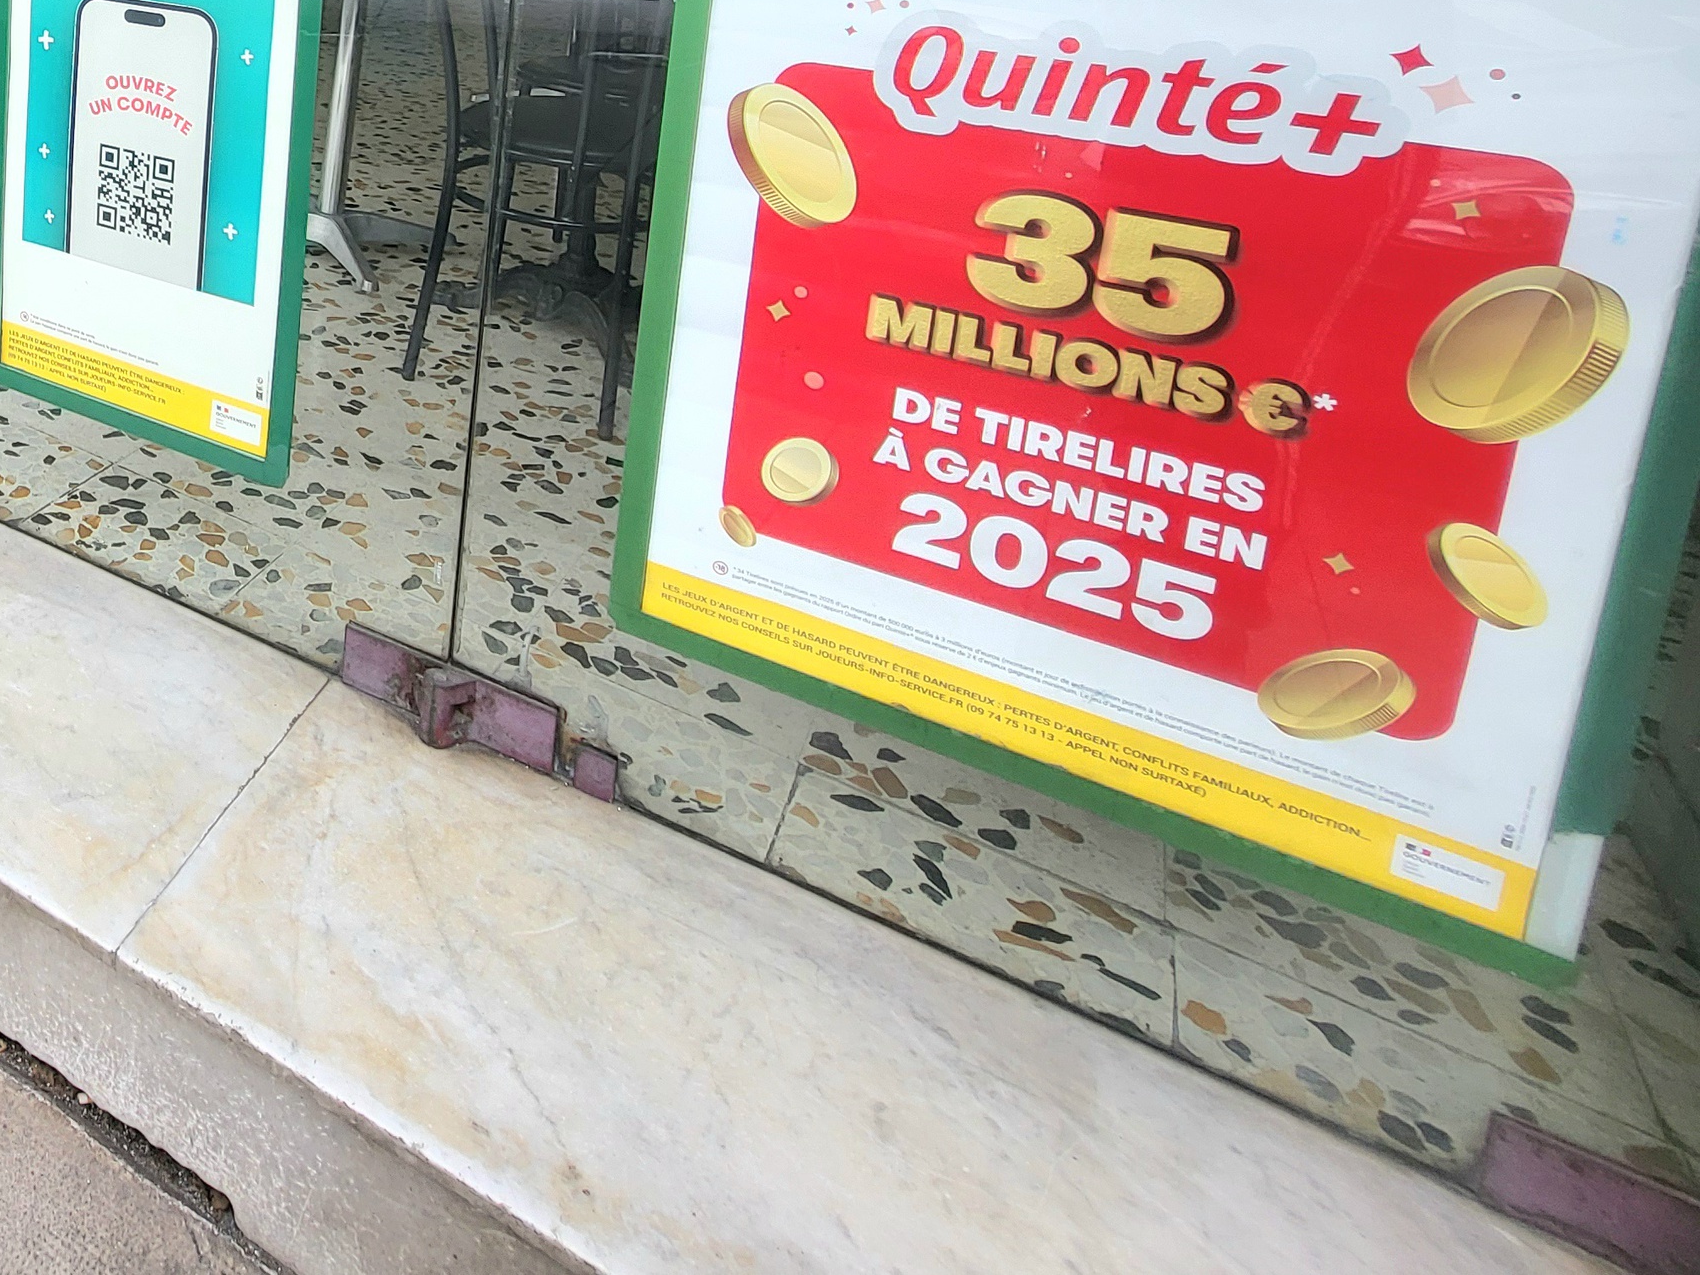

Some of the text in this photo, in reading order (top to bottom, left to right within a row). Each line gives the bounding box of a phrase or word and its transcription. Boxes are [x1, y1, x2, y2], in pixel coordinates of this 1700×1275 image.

[88, 96, 193, 136] UN COMPTE
[105, 75, 178, 102] OUVREZ
[892, 24, 1381, 157] Quinté+
[965, 192, 1238, 343] 35
[866, 294, 1232, 421] MILLIONS
[871, 426, 1268, 571] À GAGNER EN
[891, 387, 1266, 514] DE TIRELIRES
[890, 493, 1217, 643] 2025
[661, 592, 717, 619] RETROUVEZ
[717, 612, 740, 628] NOS
[741, 620, 791, 646] CONSEILS
[791, 638, 814, 655] SUR
[986, 709, 1002, 723] 74
[1004, 715, 1020, 730] 75
[1022, 722, 1038, 736] 13
[1040, 729, 1056, 743] 13
[1065, 740, 1106, 762] APPEL
[1108, 755, 1140, 775] NON
[1141, 766, 1207, 798] SURTAXÉ)
[662, 582, 681, 594] LES
[682, 589, 708, 605] JEUX
[709, 598, 760, 622] D'ARGENT
[761, 614, 775, 627] ET
[776, 620, 790, 632] DE
[791, 625, 837, 650] HASARD
[838, 643, 890, 670] PEUVENT
[891, 662, 921, 680] ÊTRE
[922, 674, 996, 707] DANGEREUX
[1003, 704, 1051, 727] PERTES
[1053, 722, 1120, 753] D'ARGENT,
[1122, 745, 1191, 777] CONFLITS
[1192, 772, 1274, 809] FAMILIAUX,
[1402, 850, 1492, 886] GOUVERNEMENT
